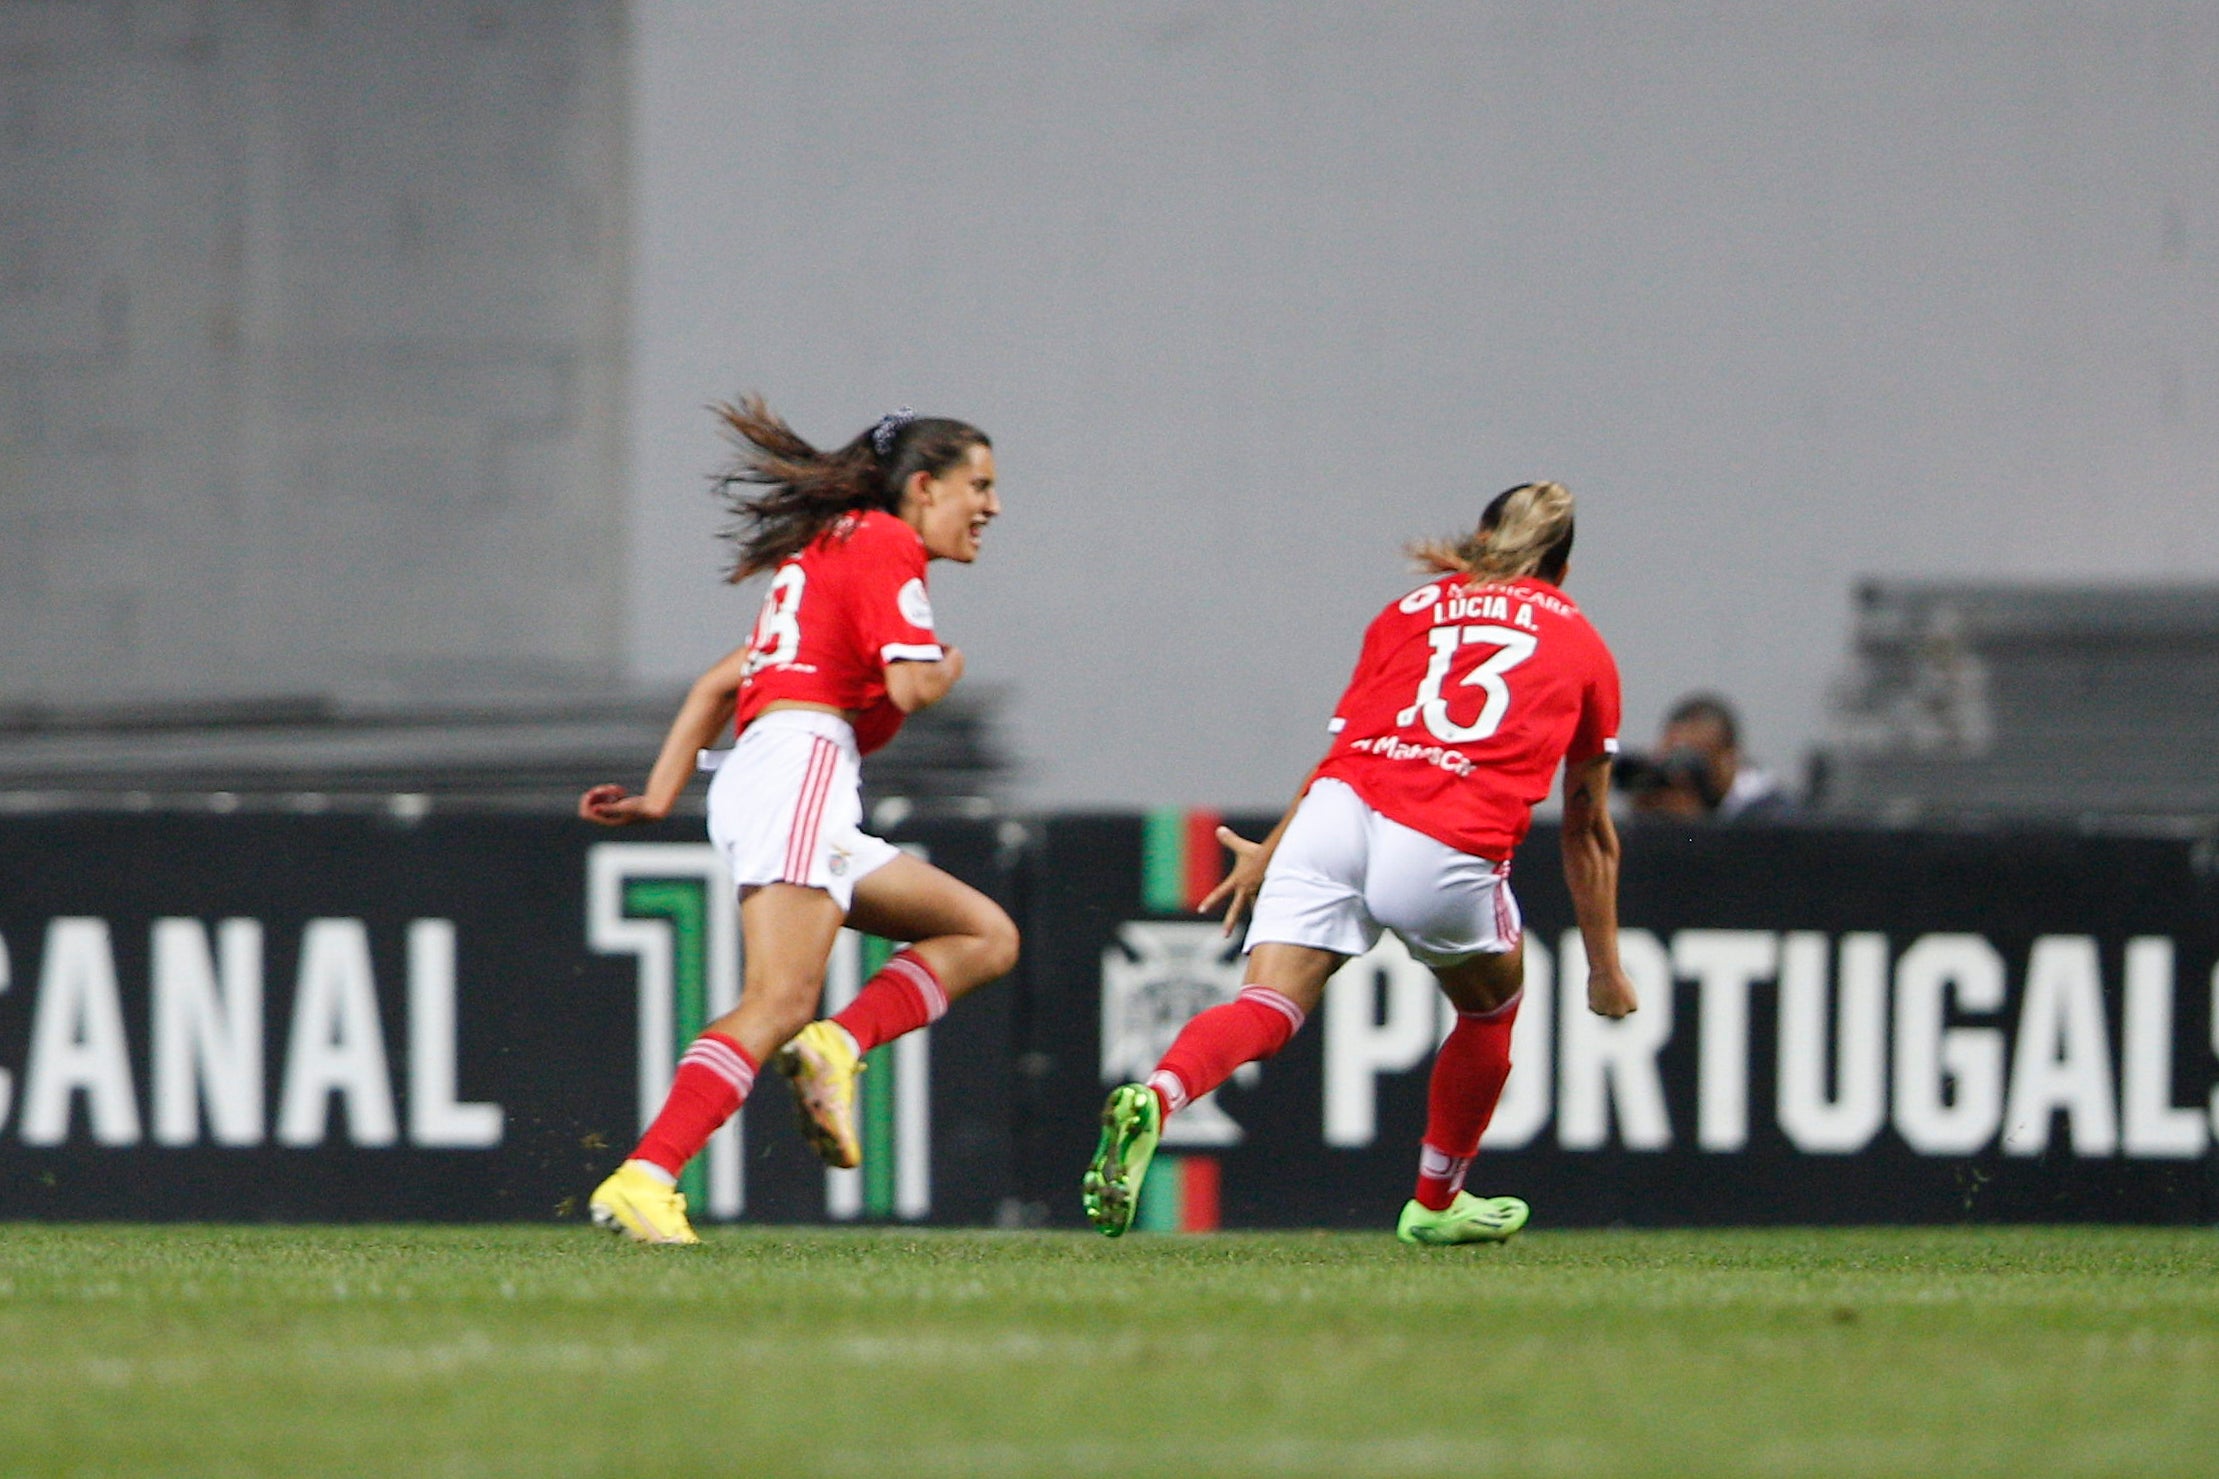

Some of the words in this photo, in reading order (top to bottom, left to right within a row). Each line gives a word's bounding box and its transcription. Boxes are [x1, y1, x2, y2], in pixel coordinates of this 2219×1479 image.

[1396, 625, 1538, 743] 13
[1514, 603, 1539, 632] A.
[0, 916, 502, 1148] ANAL
[1322, 926, 2219, 1160] PRTUGAL
